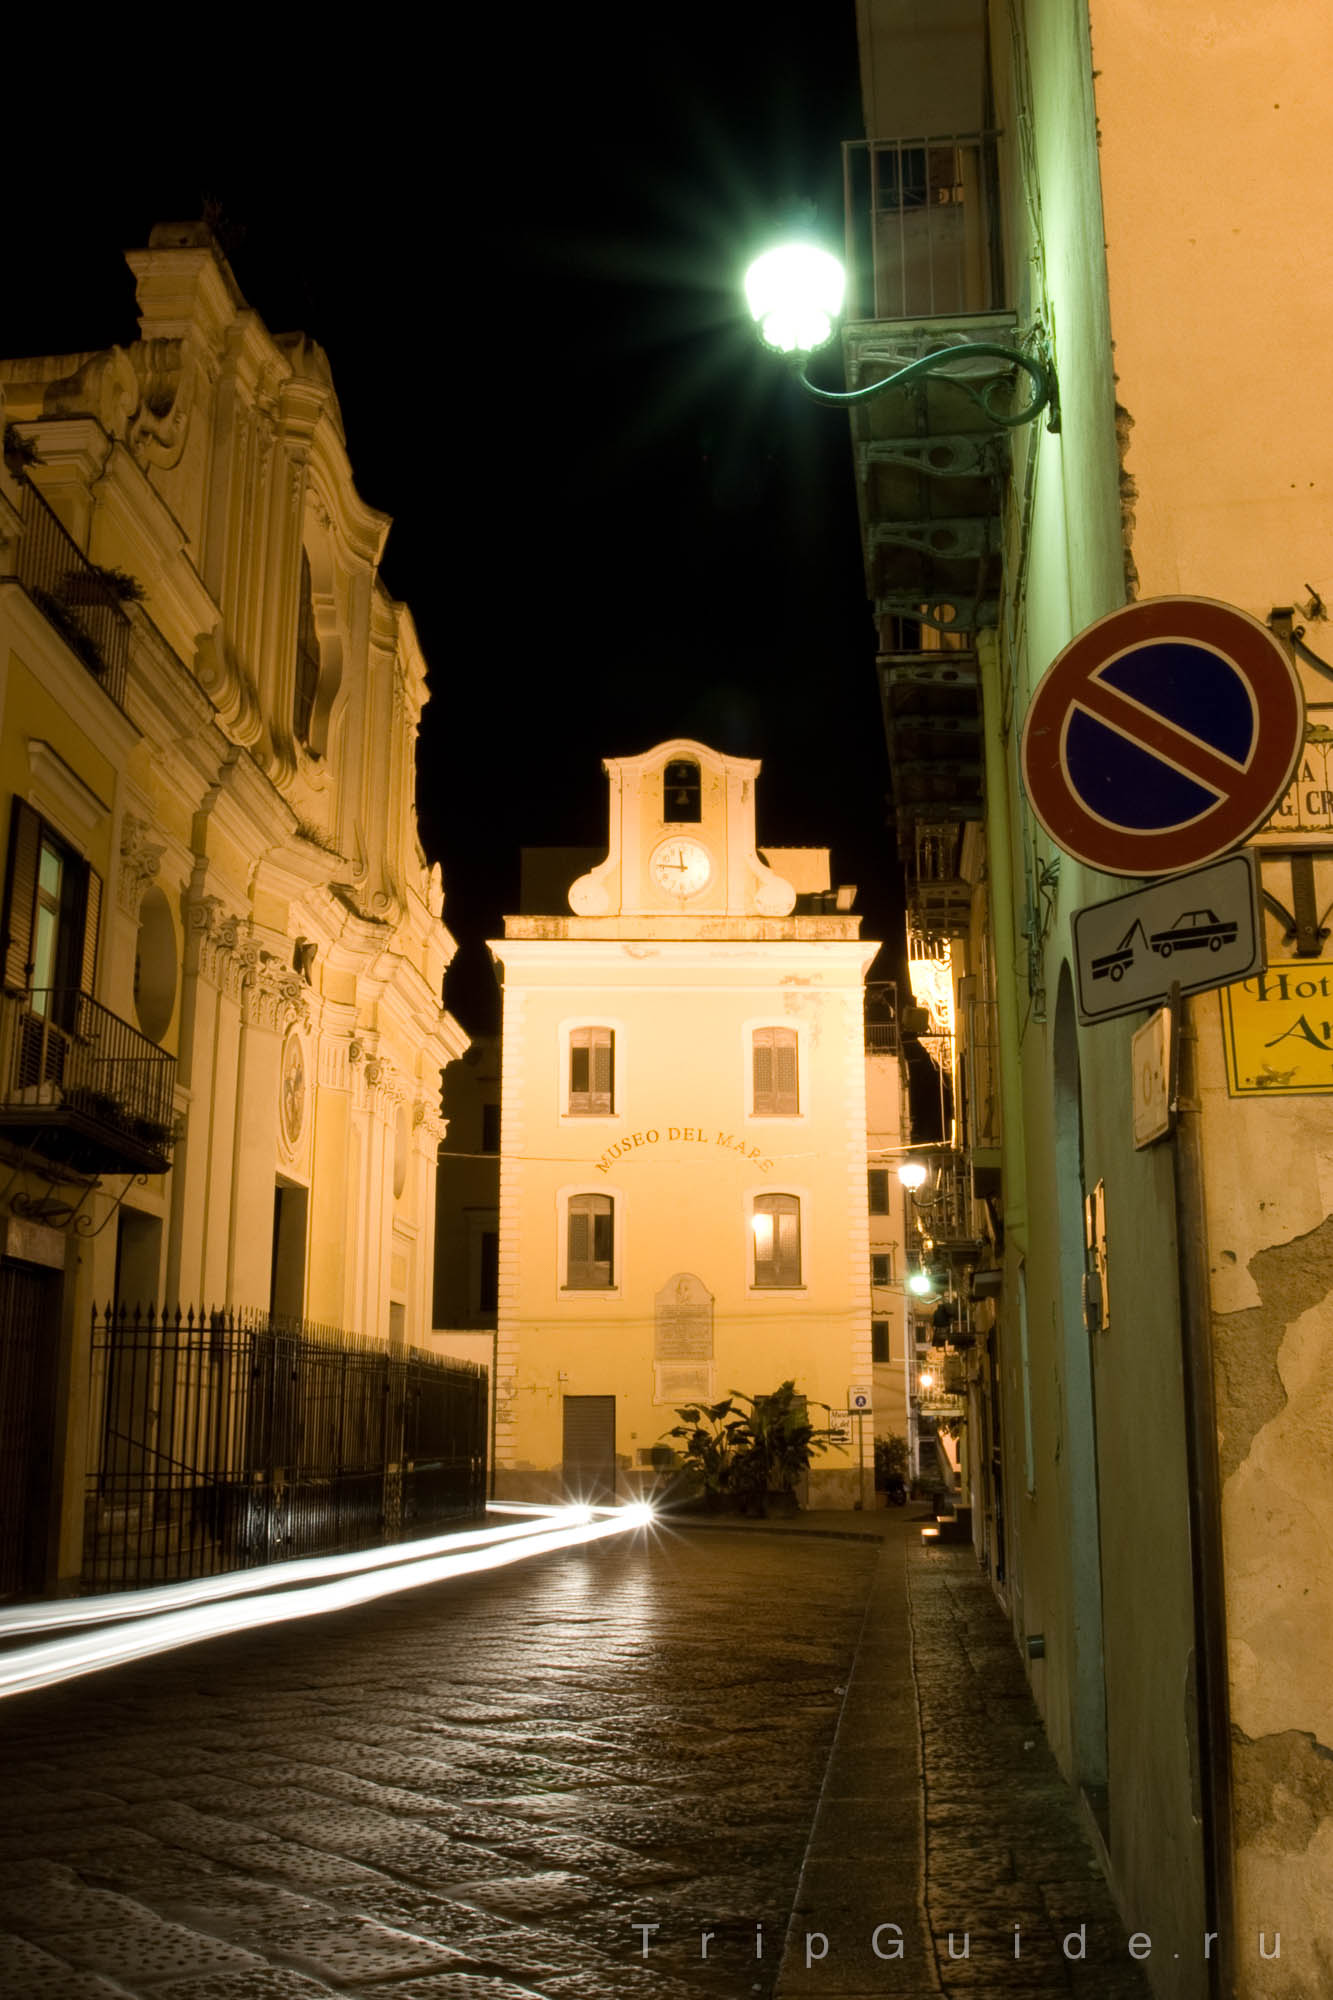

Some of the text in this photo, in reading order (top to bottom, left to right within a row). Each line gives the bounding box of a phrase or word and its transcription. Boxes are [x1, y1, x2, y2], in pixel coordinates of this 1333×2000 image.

[594, 1127, 775, 1174] MUSEO DEL MARE
